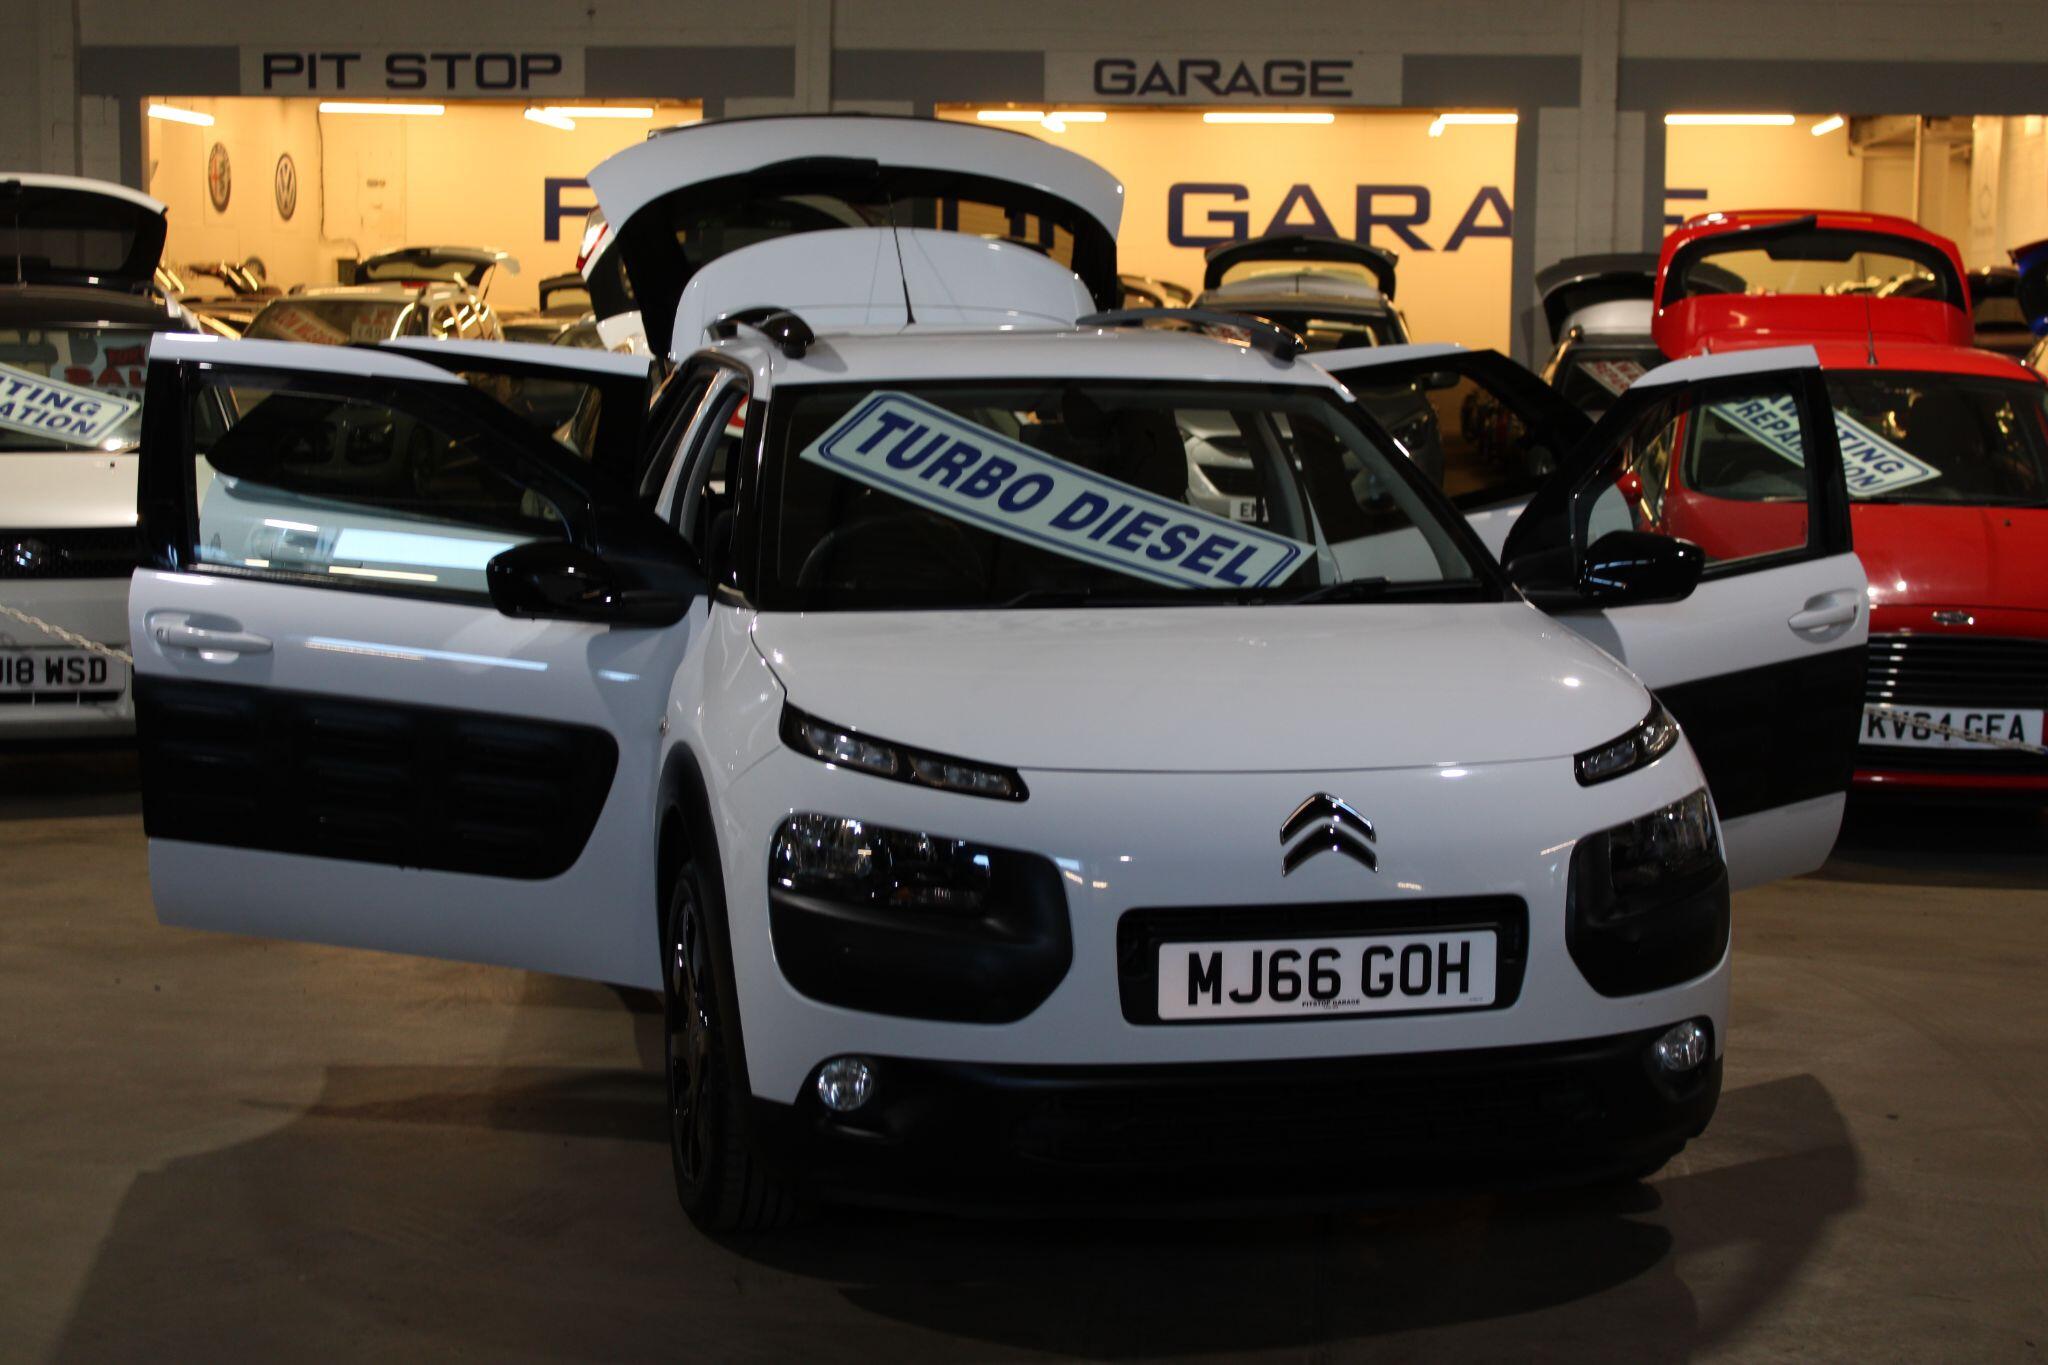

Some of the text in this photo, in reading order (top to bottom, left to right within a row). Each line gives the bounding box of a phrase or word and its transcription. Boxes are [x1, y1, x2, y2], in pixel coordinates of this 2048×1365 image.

[263, 53, 562, 89] PIT STOP
[1094, 58, 1353, 97] GARAGE
[0, 377, 101, 416] TING
[855, 410, 1258, 585] TURBO DIESEL
[0, 657, 107, 684] 18 WSD
[1868, 711, 1951, 741] KV64
[1188, 941, 1470, 1005] MJ66 GOH
